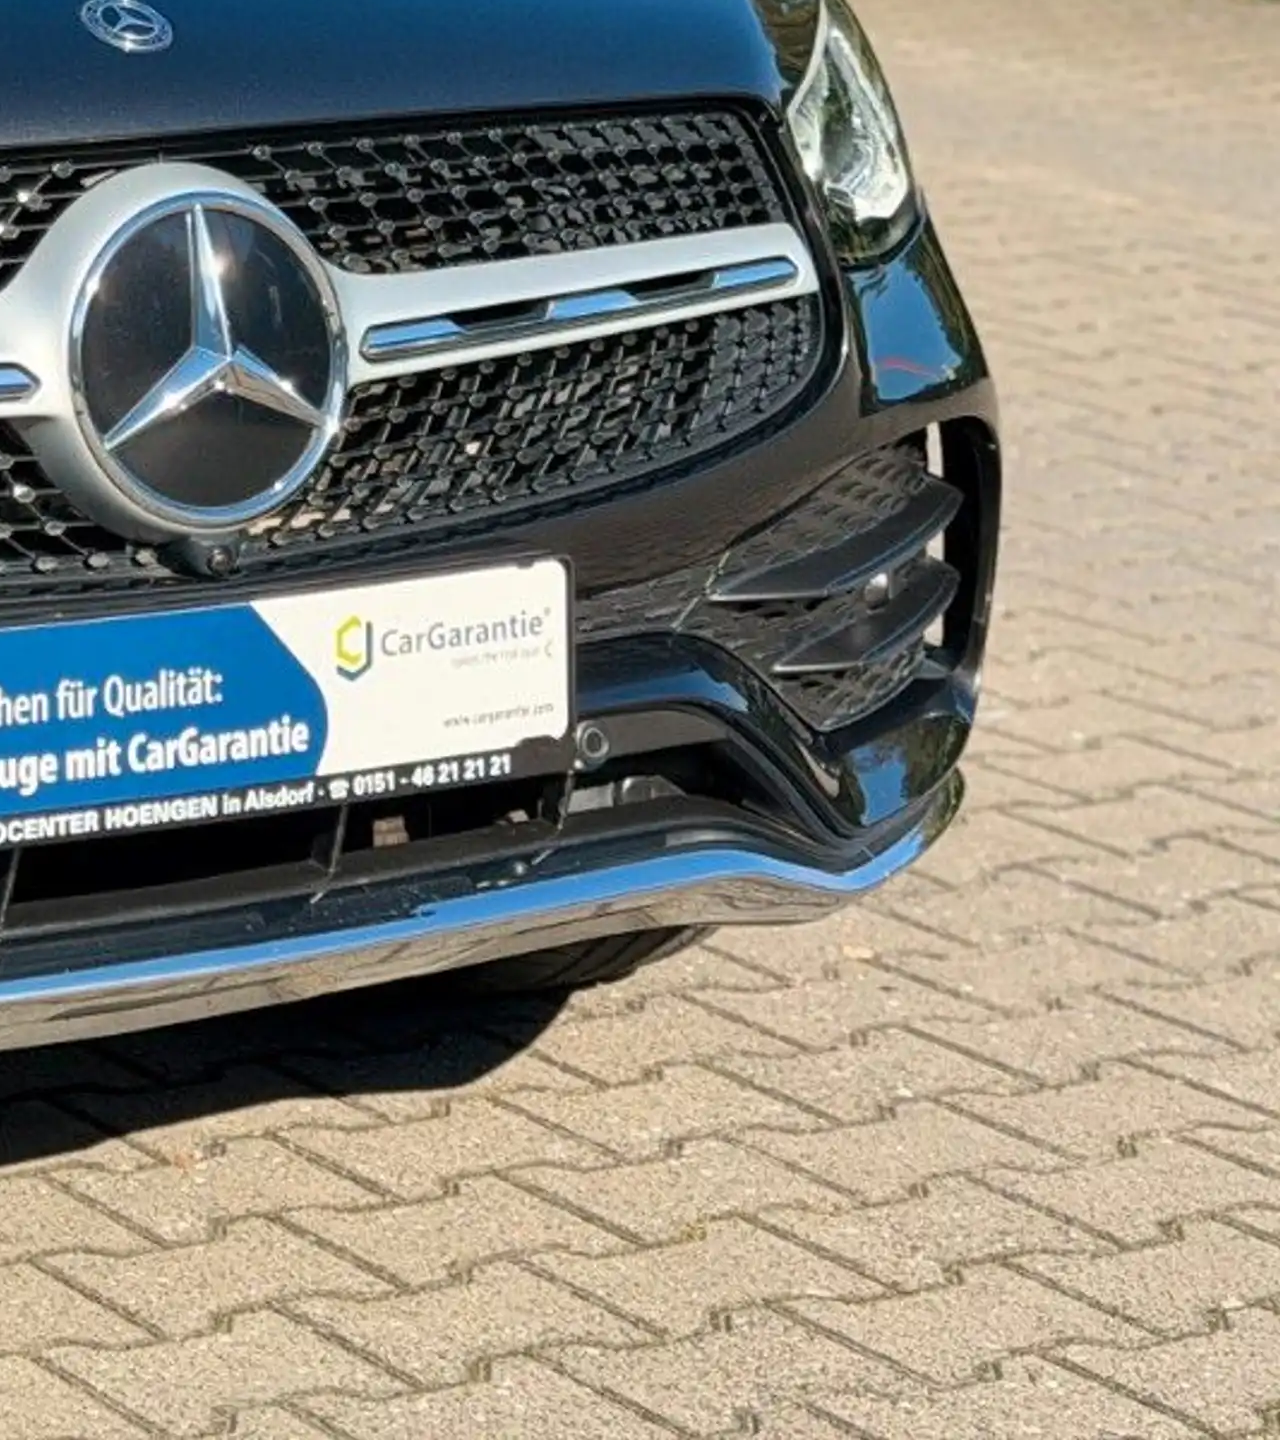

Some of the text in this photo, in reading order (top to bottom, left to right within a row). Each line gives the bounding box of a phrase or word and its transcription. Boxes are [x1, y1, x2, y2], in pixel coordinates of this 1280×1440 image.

[381, 609, 543, 656] CarGarantie
[56, 678, 98, 721] für
[103, 666, 224, 717] Qualität:
[65, 736, 122, 781] mit
[127, 713, 310, 773] CarGarantie
[103, 793, 218, 830] HOENGEN
[222, 793, 241, 815] in
[243, 781, 315, 812] Alsdorf
[352, 770, 396, 796] 0151
[438, 761, 460, 784] 21
[462, 757, 486, 779] 21
[489, 753, 512, 776] 21
